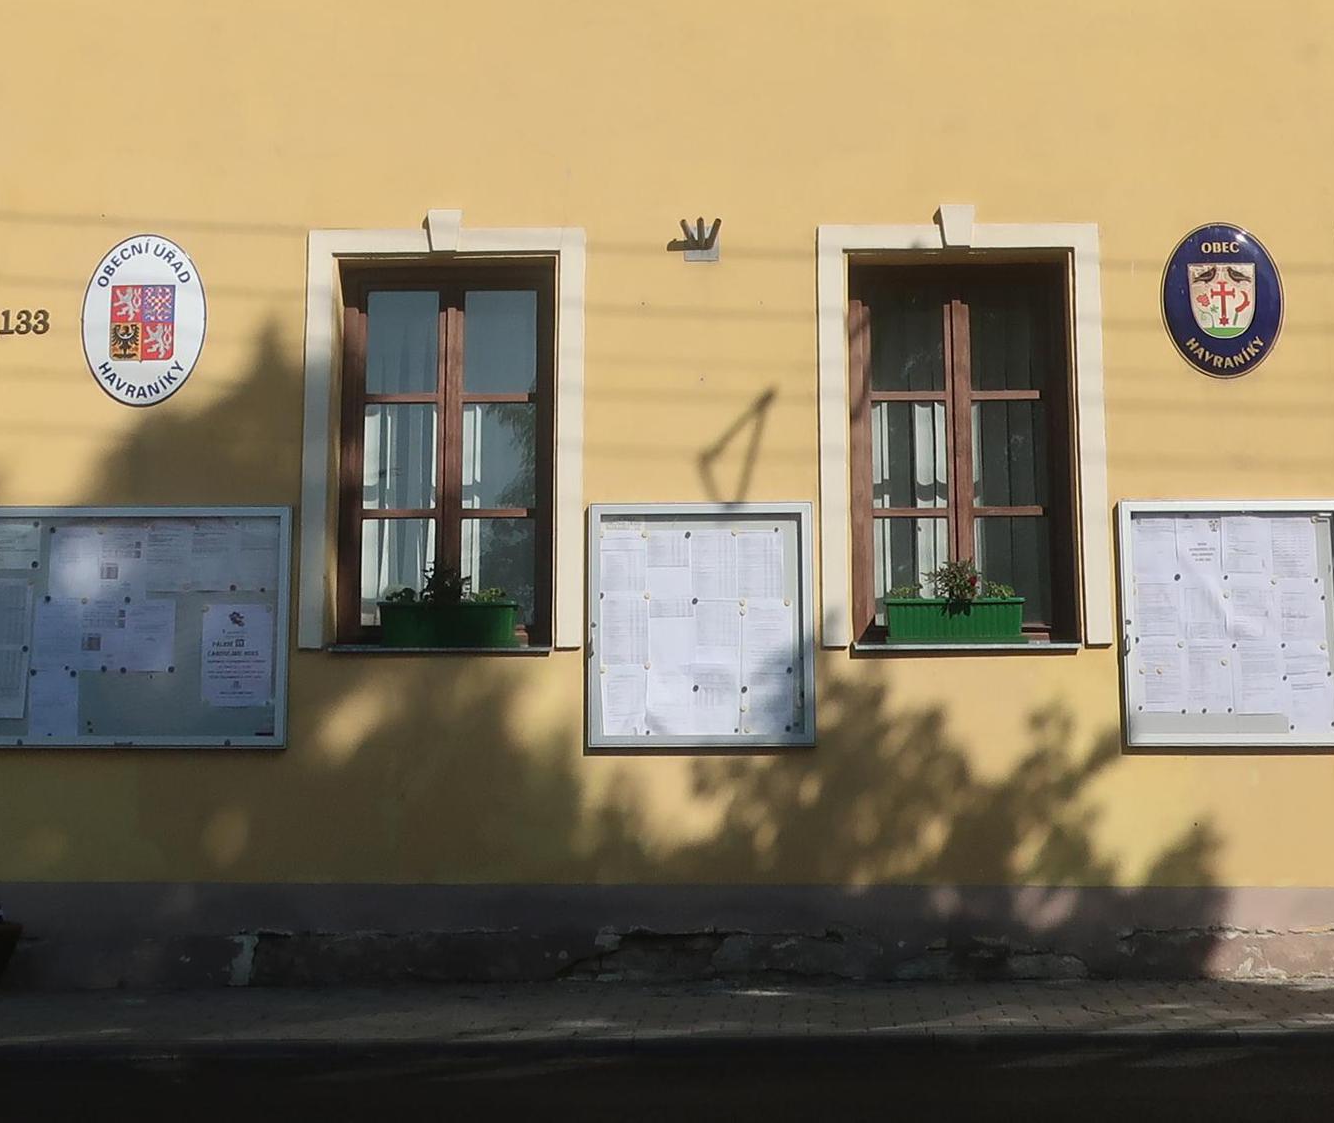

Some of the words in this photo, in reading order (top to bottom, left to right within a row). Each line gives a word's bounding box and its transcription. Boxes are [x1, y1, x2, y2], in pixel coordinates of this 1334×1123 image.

[97, 239, 152, 288] OBECNÍ
[153, 242, 191, 285] ÚŘAD
[1201, 241, 1240, 254] OBEC
[1185, 335, 1265, 369] HAVRANÍKY
[98, 360, 185, 399] HAVRANÍKY
